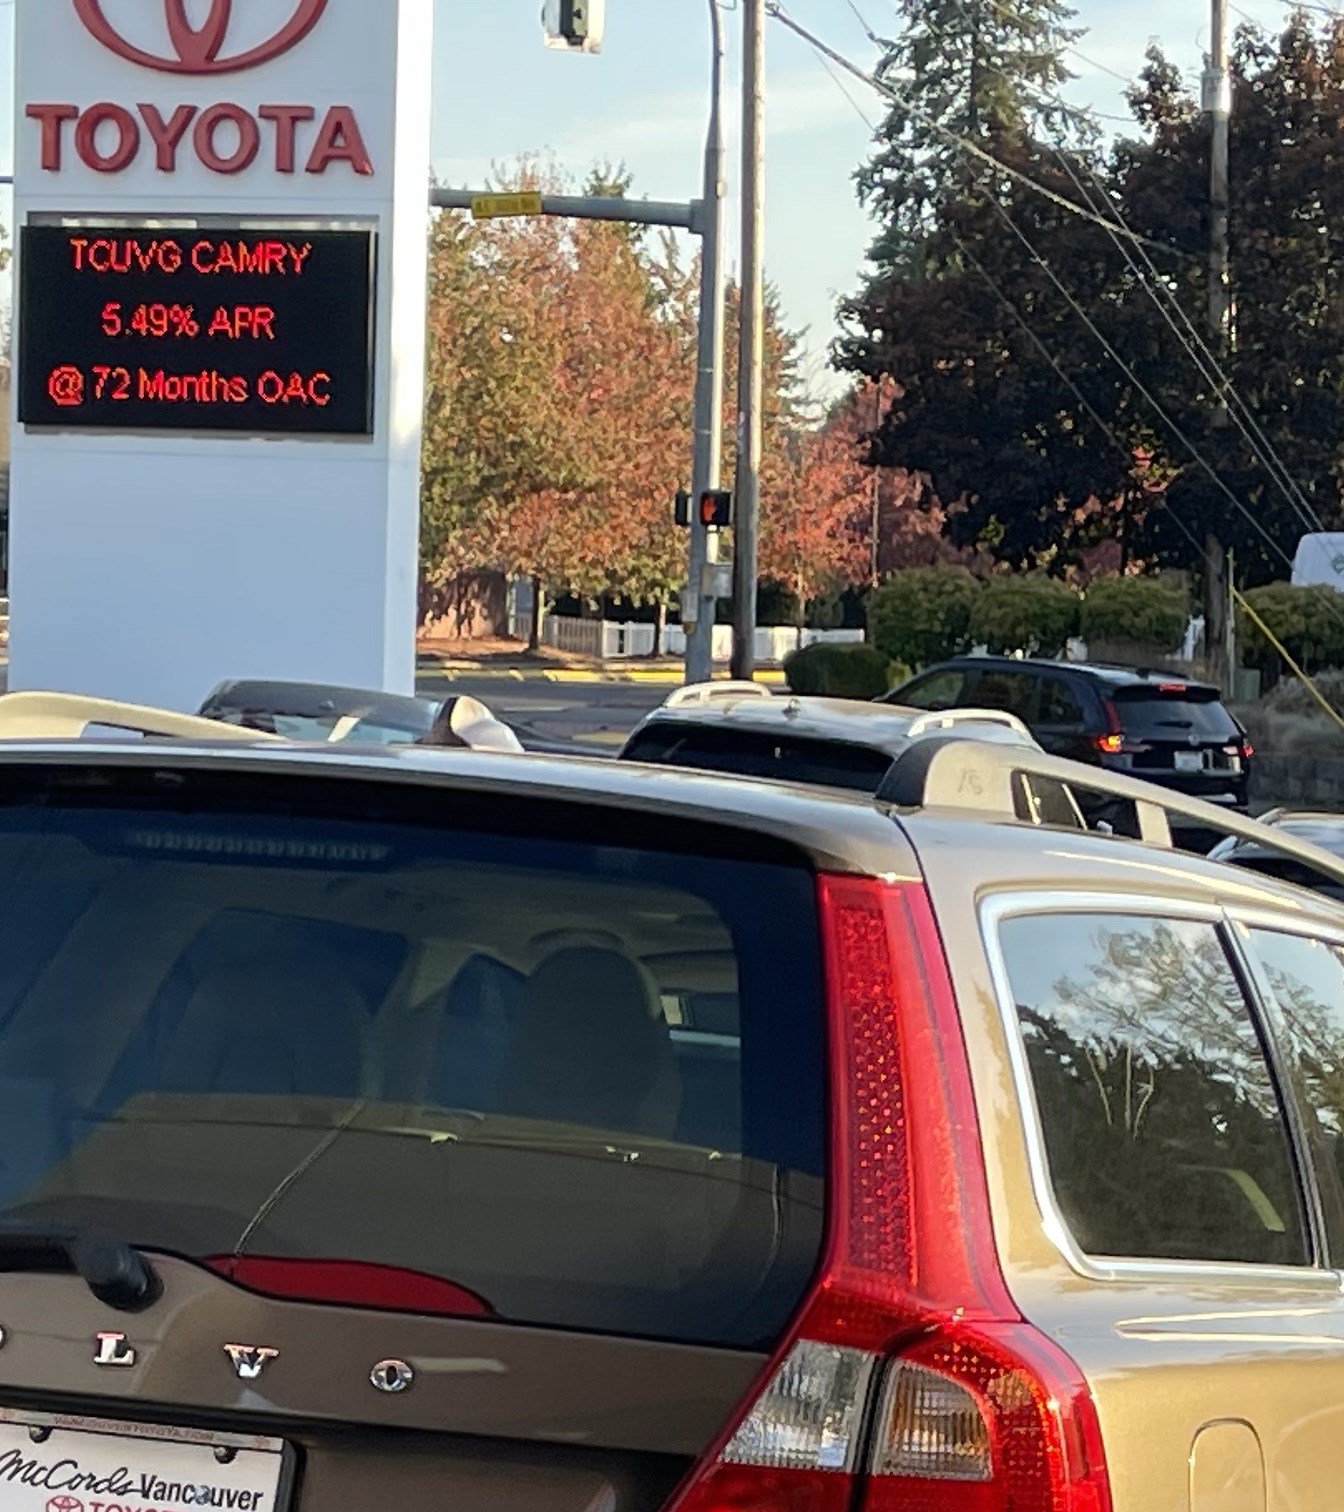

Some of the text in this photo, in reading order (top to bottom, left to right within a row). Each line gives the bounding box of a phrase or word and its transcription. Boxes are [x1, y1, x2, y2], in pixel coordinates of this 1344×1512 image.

[25, 102, 374, 175] TOYOTA
[191, 239, 313, 276] CAMRY
[101, 302, 277, 340] 5.49% APR
[47, 365, 332, 407] @ 72 Months OAC
